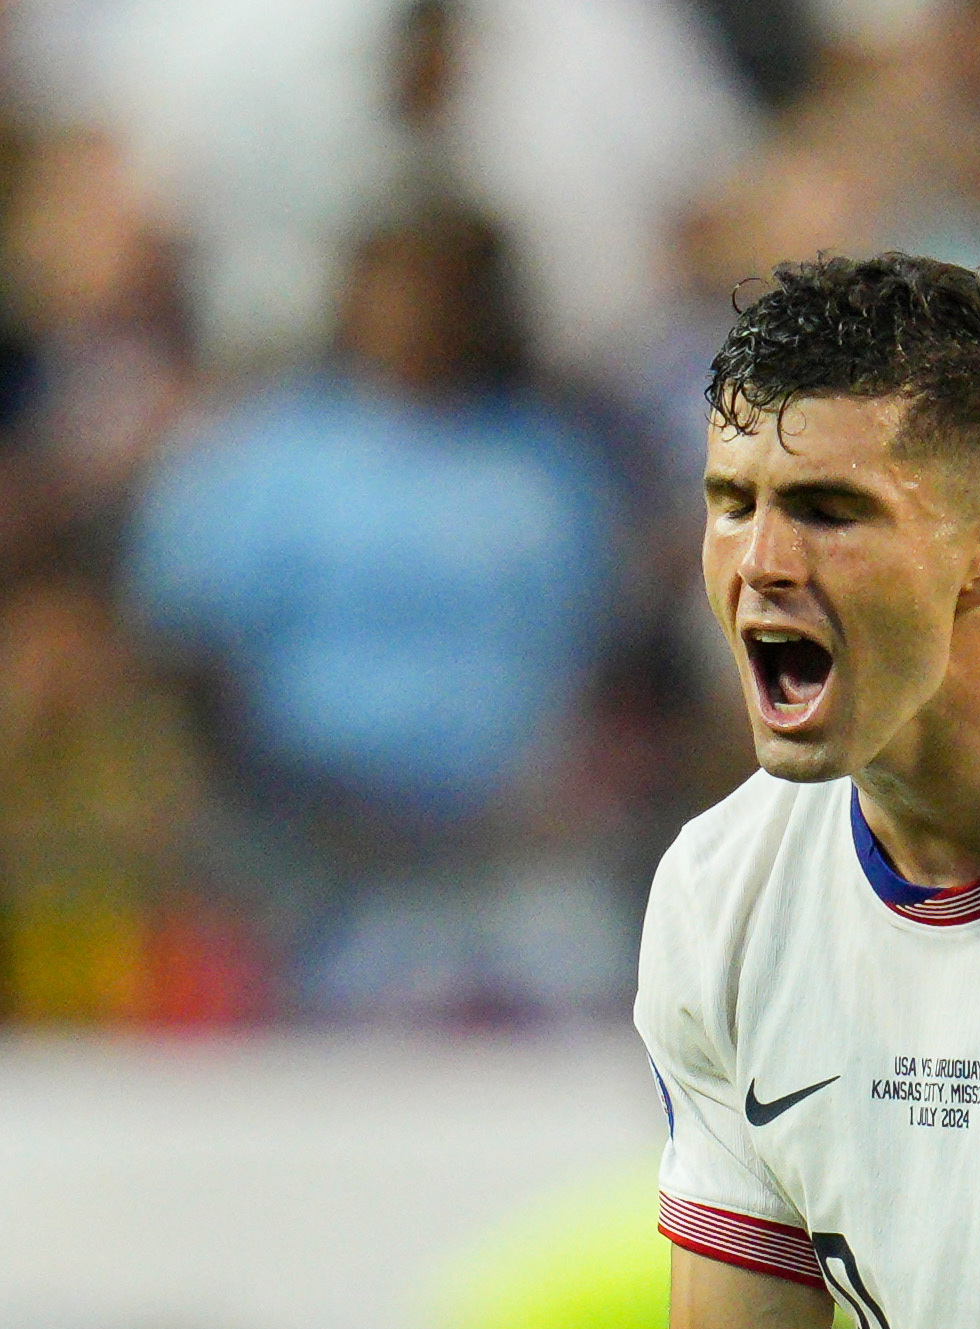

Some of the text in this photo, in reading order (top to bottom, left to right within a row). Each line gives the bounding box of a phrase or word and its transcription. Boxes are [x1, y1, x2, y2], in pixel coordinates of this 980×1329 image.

[894, 1056, 917, 1077] USA
[871, 1079, 922, 1101] KANSAS
[909, 1105, 970, 1128] 1 JULY 2024
